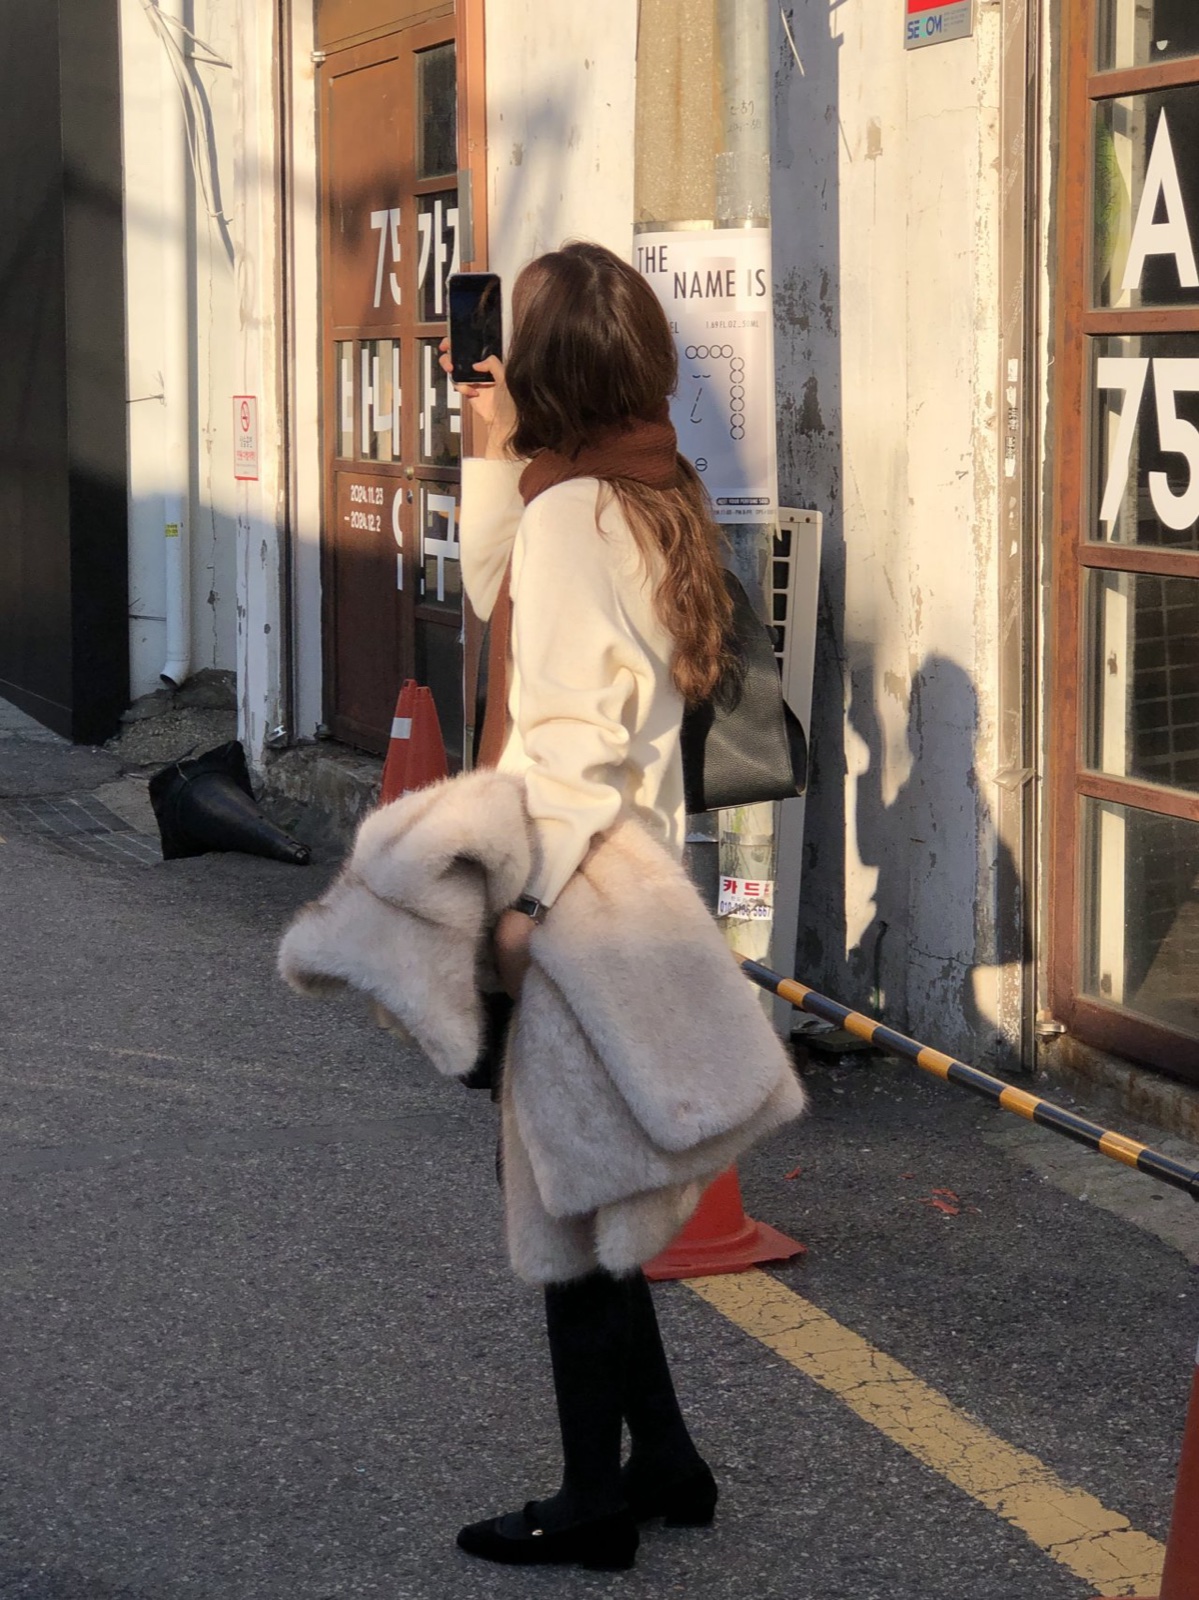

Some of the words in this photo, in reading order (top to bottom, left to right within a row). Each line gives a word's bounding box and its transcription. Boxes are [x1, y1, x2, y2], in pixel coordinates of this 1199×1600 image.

[907, 14, 942, 40] SECOM
[1121, 106, 1199, 290] A
[638, 245, 668, 275] THE
[674, 269, 736, 300] NAME
[746, 268, 766, 297] IS
[1097, 357, 1199, 531] 75
